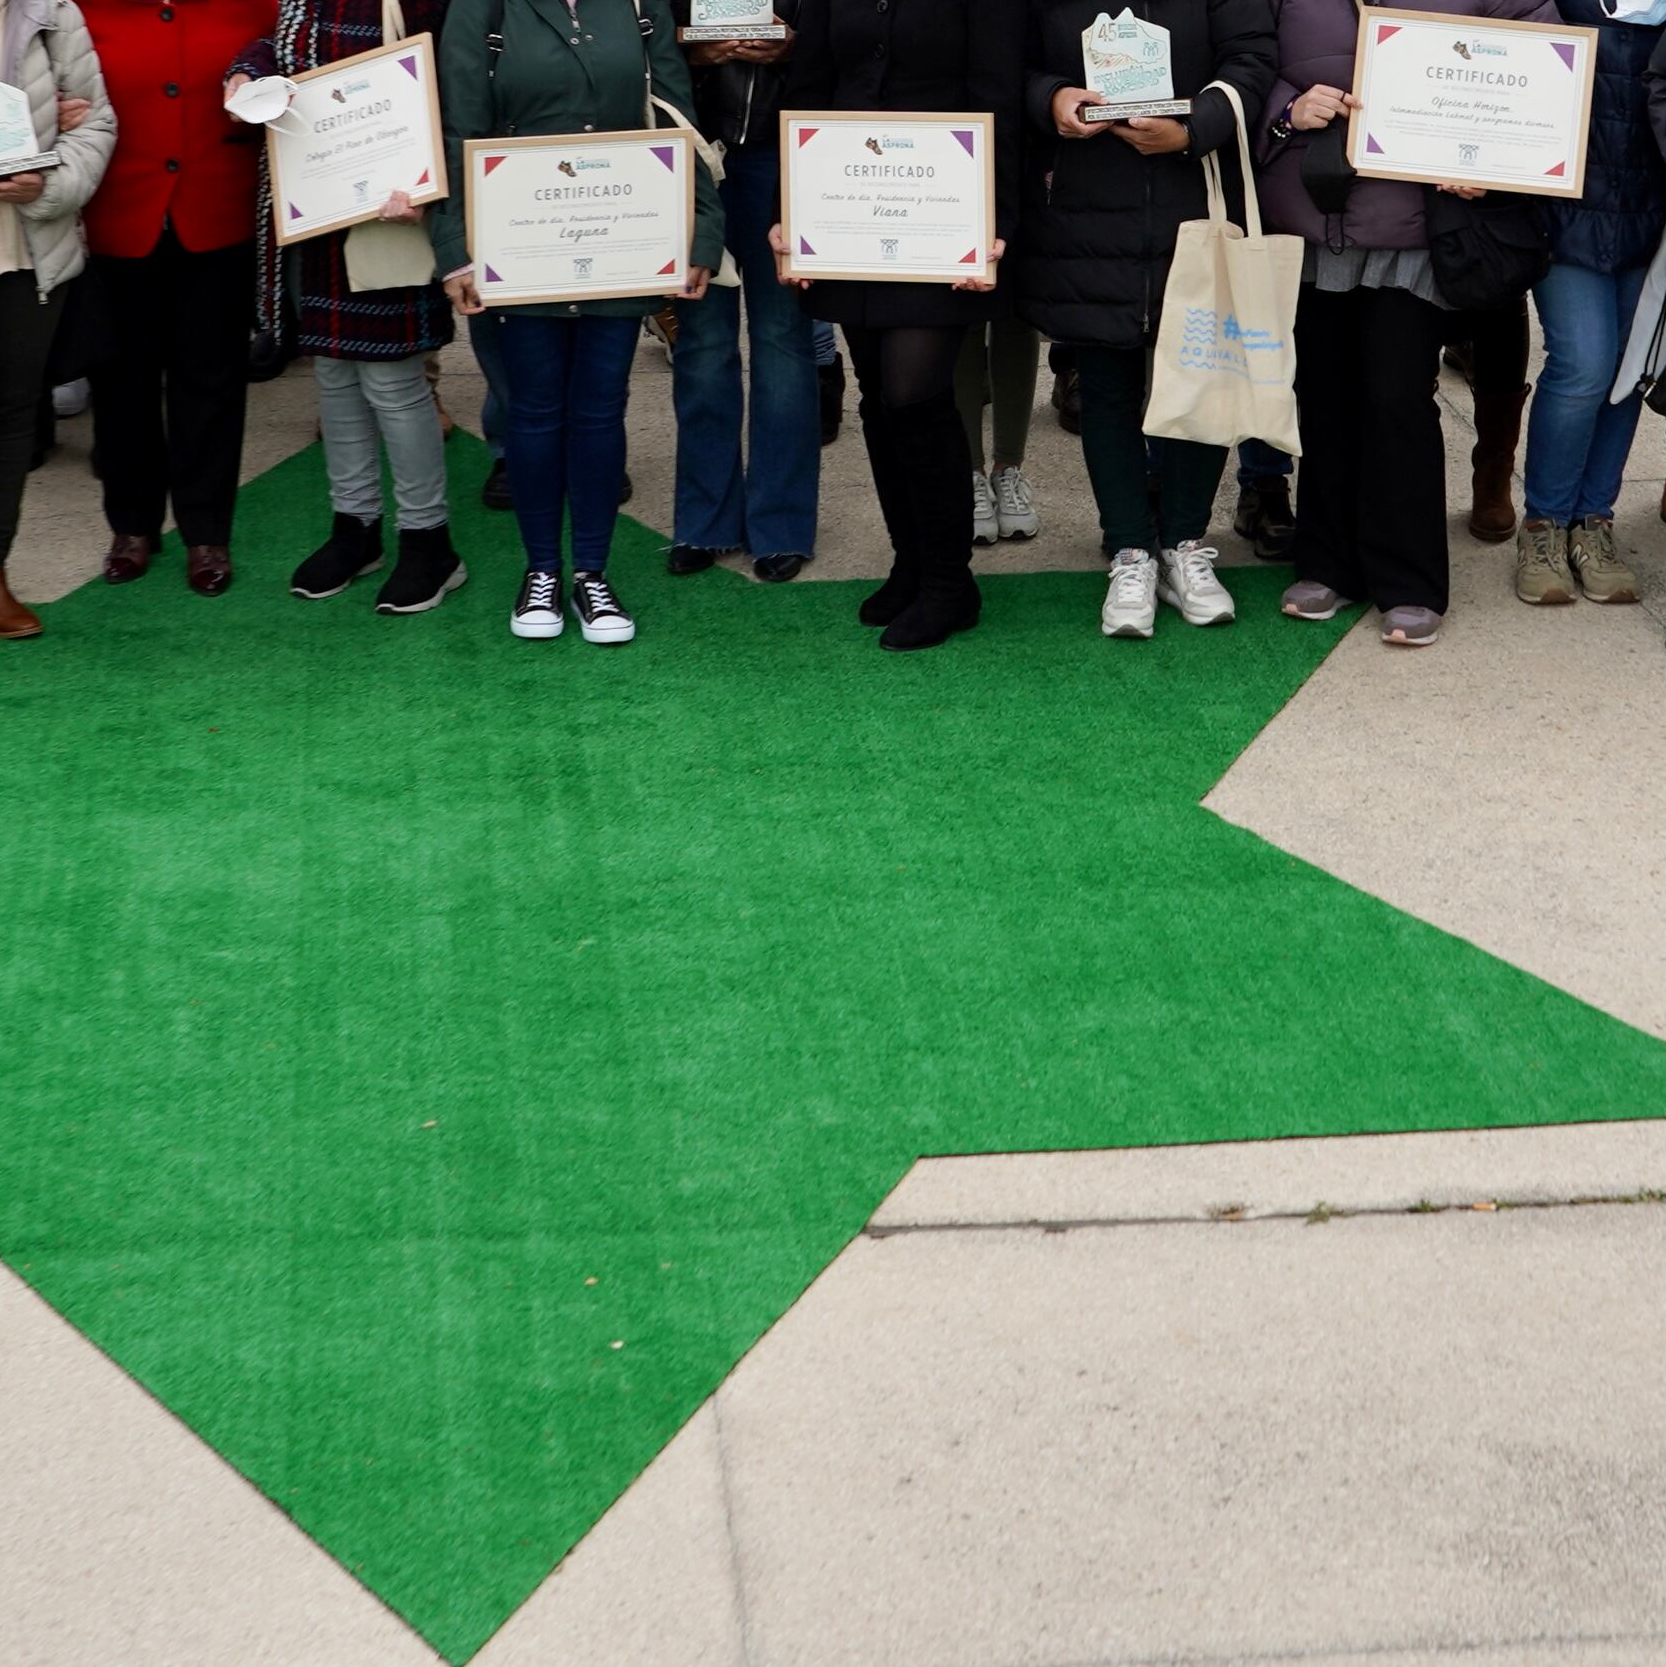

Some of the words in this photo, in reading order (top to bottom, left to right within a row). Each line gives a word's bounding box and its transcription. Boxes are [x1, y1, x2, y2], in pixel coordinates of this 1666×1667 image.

[1098, 23, 1117, 41] 45
[1426, 66, 1529, 88] CERTIFICADO
[1431, 96, 1469, 110] Oficina
[314, 99, 392, 134] CERTIFICADO
[844, 164, 935, 178] CERTIFICADO
[534, 183, 633, 201] CERTIFICADO
[872, 205, 909, 217] Viana
[559, 226, 610, 243] Laguna
